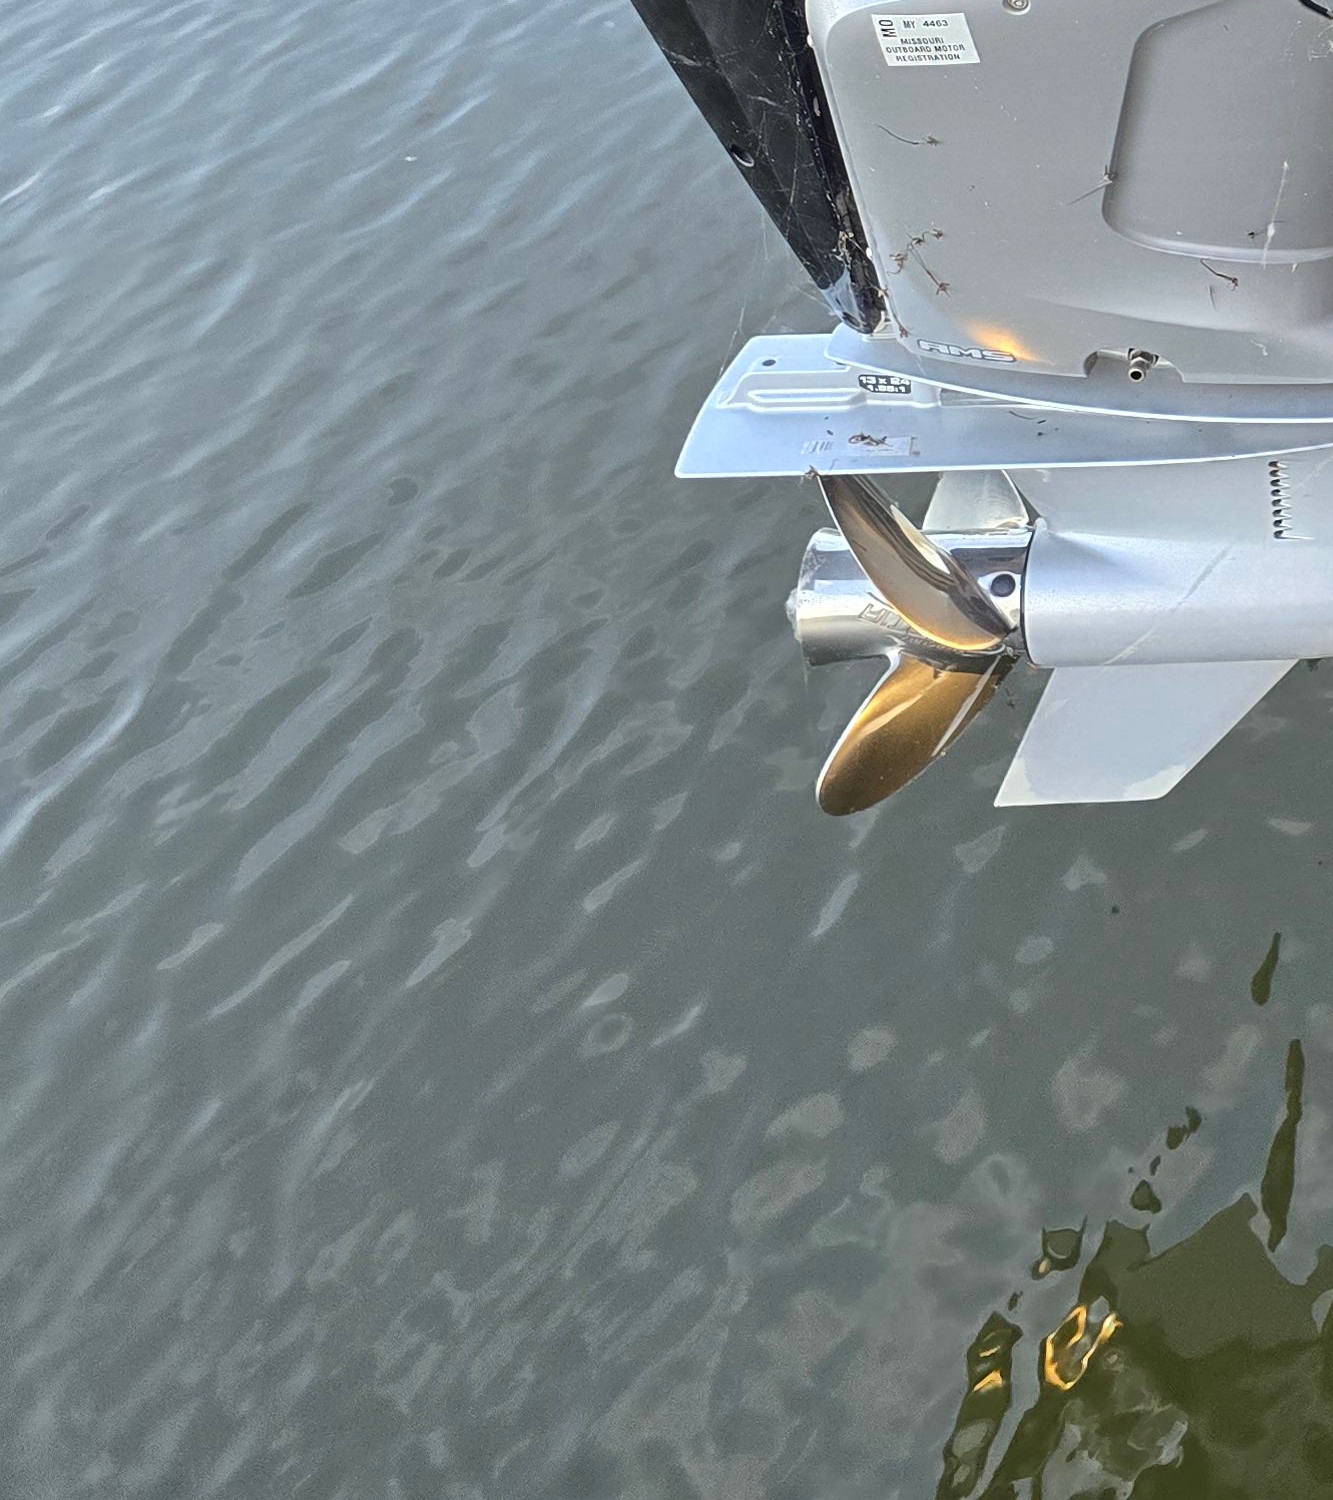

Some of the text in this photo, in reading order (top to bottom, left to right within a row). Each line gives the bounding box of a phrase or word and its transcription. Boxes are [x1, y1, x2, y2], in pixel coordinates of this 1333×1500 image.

[879, 19, 898, 38] MO
[903, 20, 916, 29] MY
[900, 37, 945, 45] MISSOURI
[885, 44, 966, 54] OUTBOARD MOTOR
[895, 53, 961, 62] REGISTRATION
